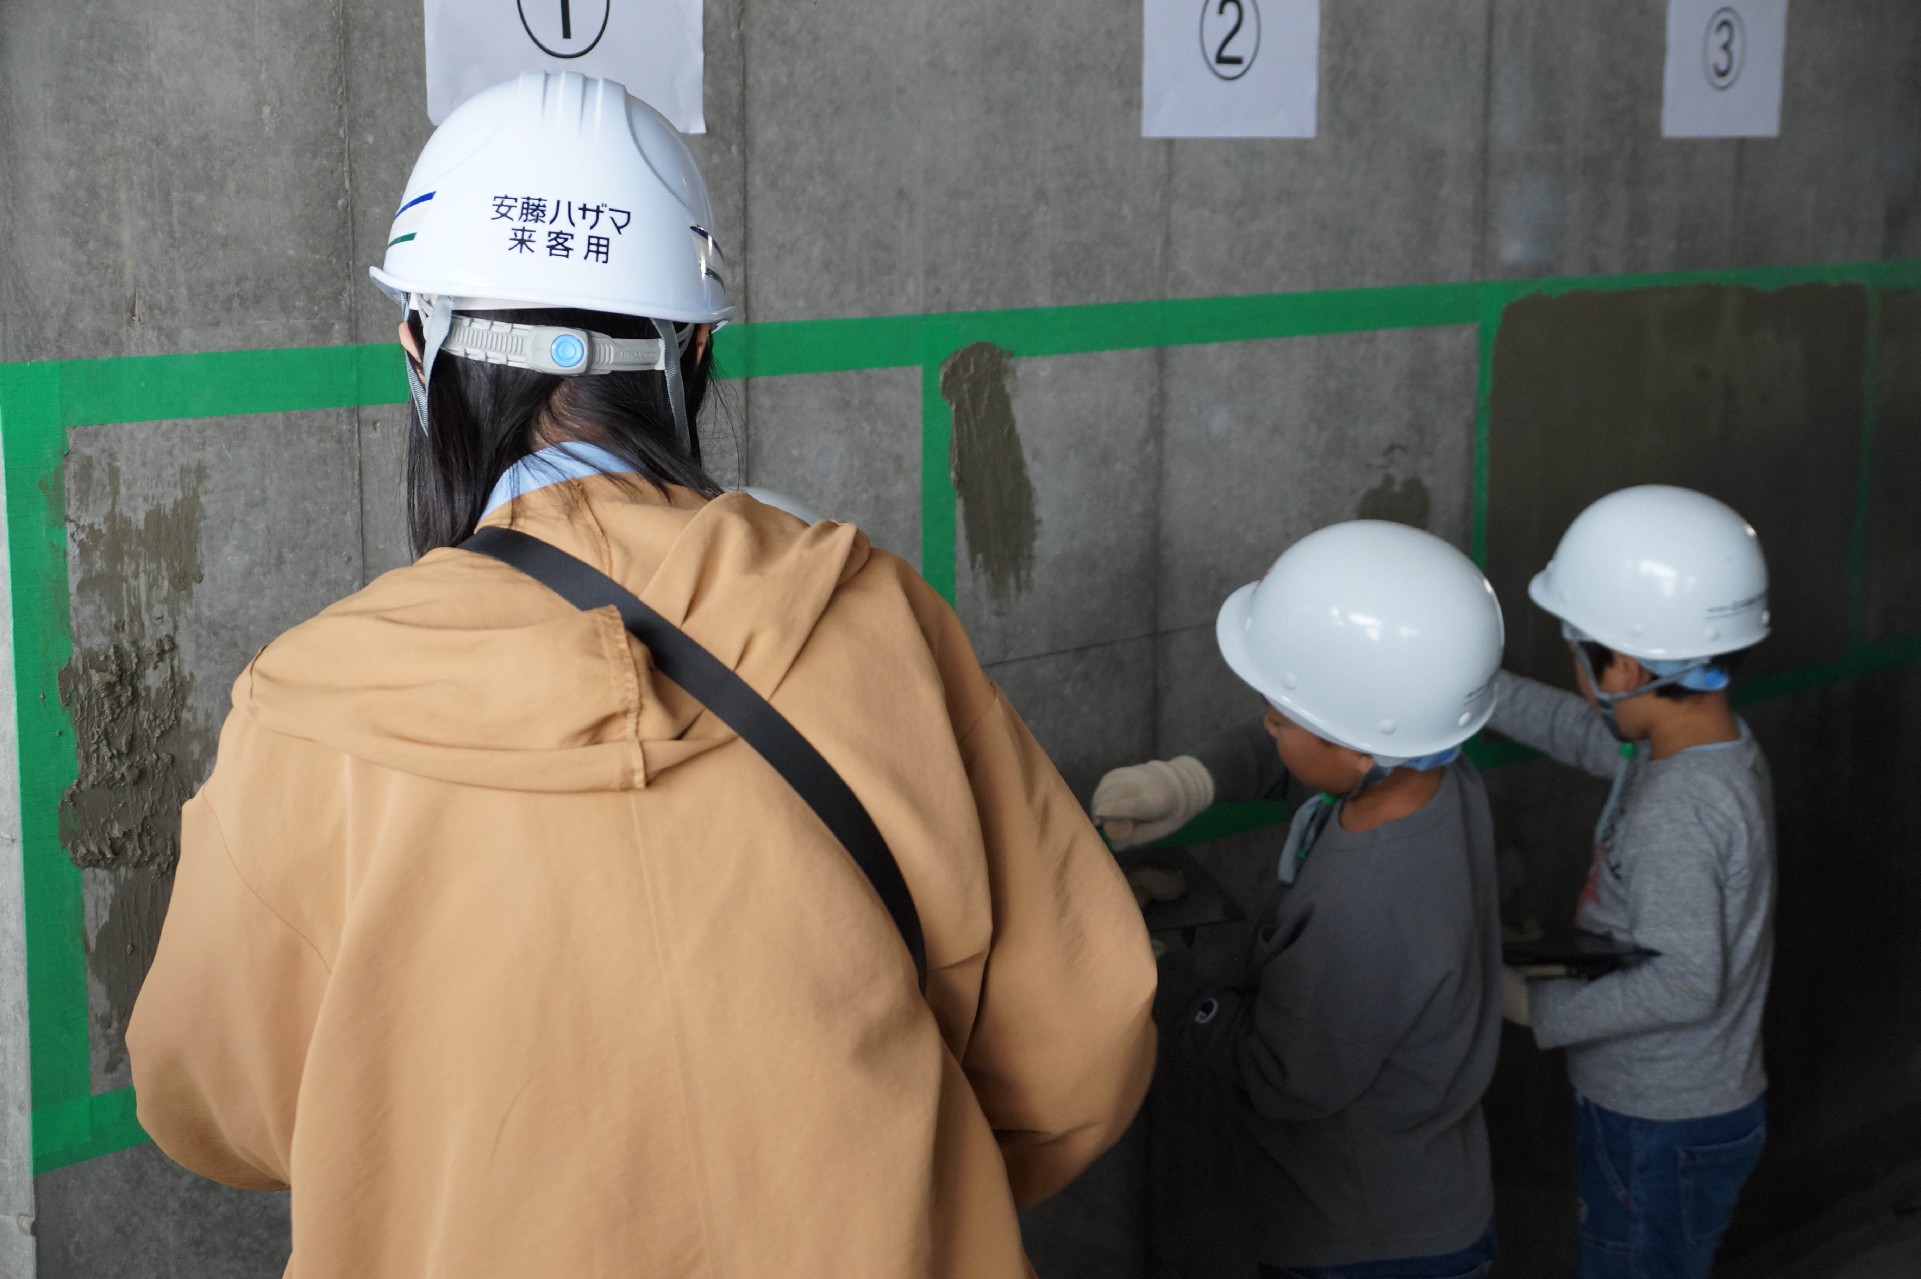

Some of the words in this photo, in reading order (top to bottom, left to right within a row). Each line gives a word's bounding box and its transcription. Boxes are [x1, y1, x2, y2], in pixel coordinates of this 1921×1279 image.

[491, 195, 631, 235] 安藤ハザマ
[508, 227, 610, 264] 来客用
